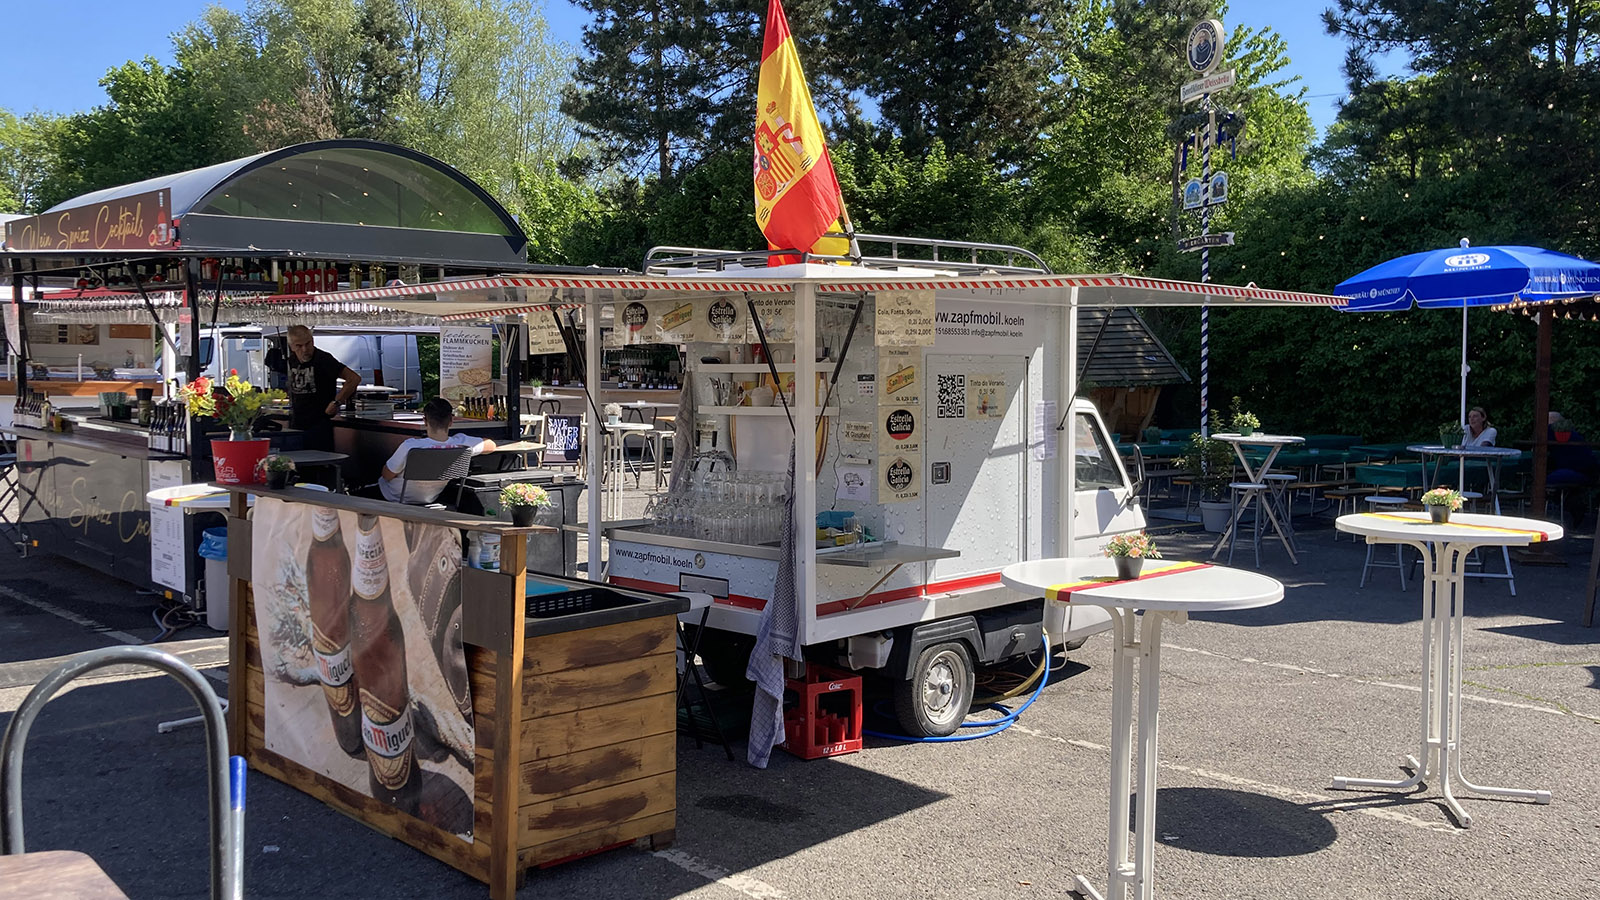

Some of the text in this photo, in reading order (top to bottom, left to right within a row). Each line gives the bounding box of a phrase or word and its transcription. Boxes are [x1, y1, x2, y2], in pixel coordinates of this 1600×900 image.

[21, 216, 52, 250] Wein
[95, 202, 144, 249] Cocktails
[443, 337, 490, 346] FLAMMKUCHEN
[548, 419, 568, 427] SAVE
[890, 414, 912, 423] Estrella
[548, 427, 579, 436] WATER
[891, 422, 911, 432] Galicia
[554, 435, 578, 444] DRINK
[615, 548, 693, 569] www.zapfmobil.koeln
